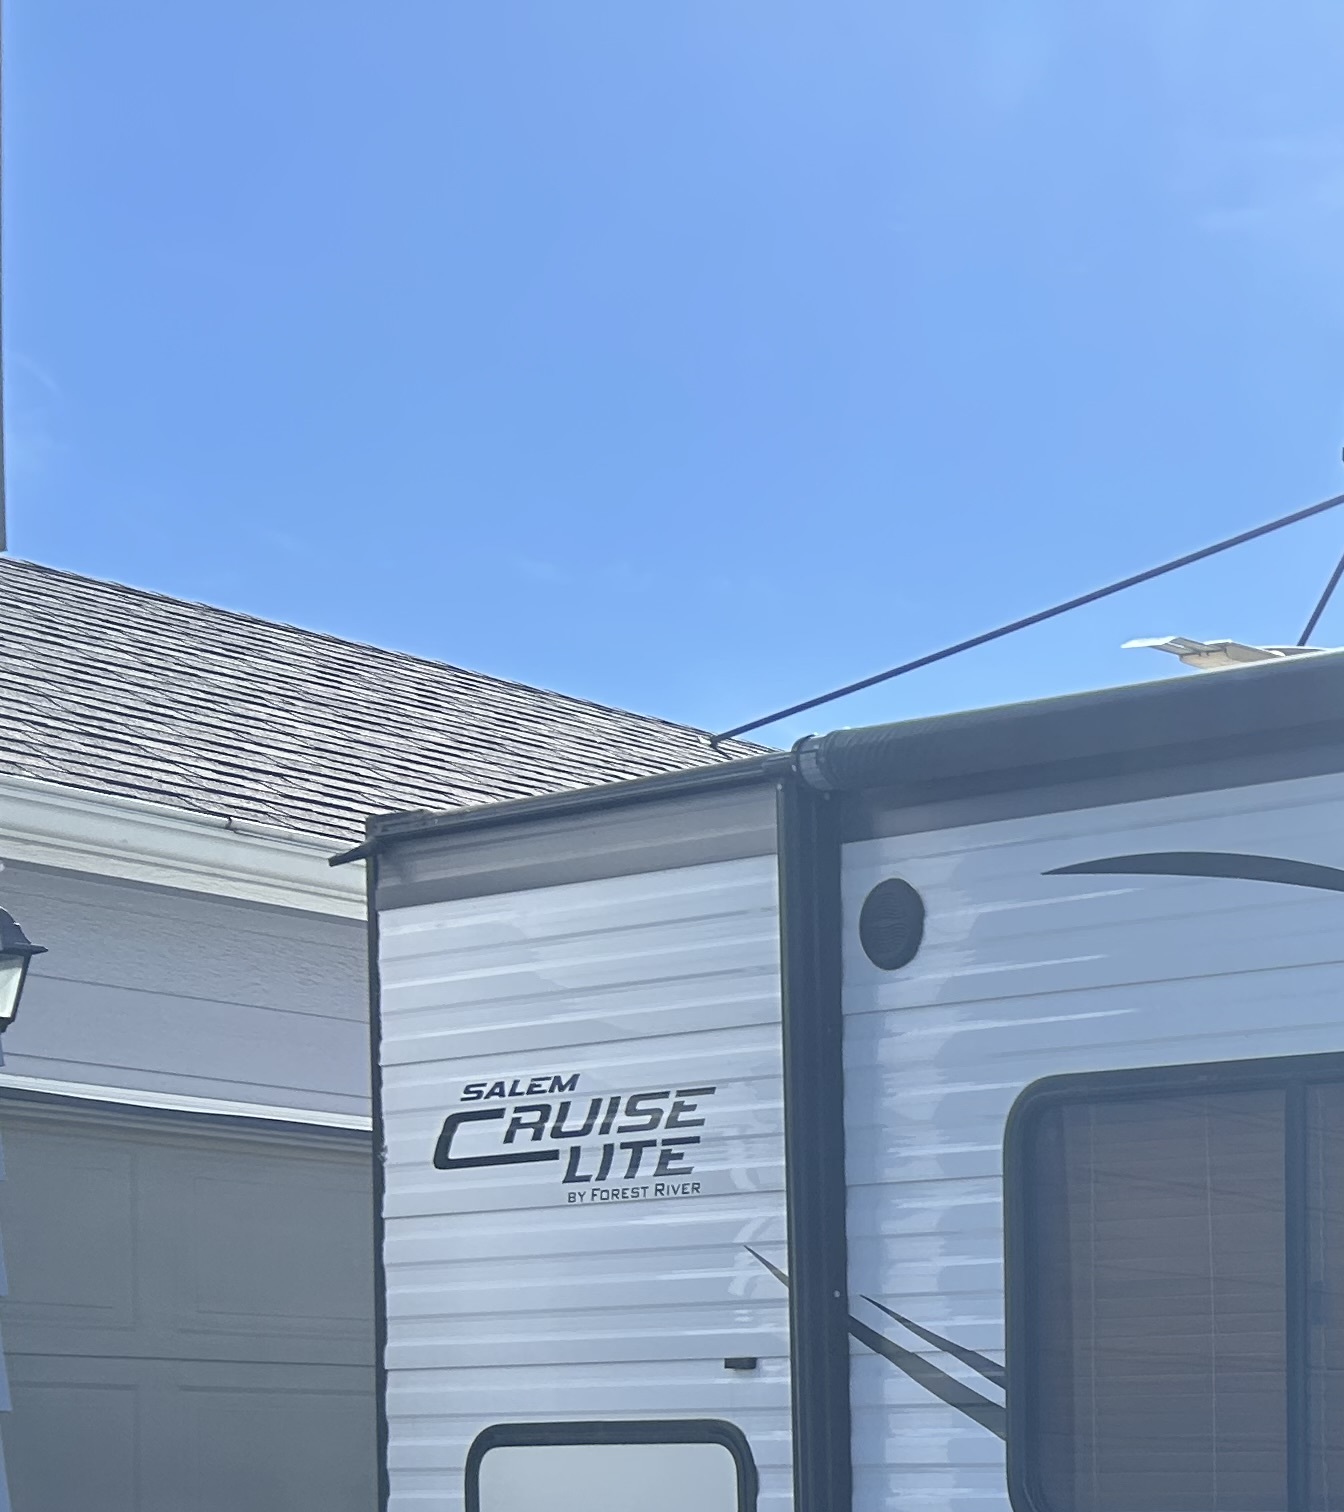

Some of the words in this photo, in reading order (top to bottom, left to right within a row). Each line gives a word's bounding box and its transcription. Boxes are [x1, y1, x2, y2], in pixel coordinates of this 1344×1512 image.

[460, 1073, 580, 1102] SALEM
[433, 1086, 717, 1170] CRUISE
[562, 1136, 700, 1184] LITE
[567, 1191, 587, 1203] BY
[590, 1186, 649, 1202] FOREST
[654, 1182, 701, 1197] RIVER
